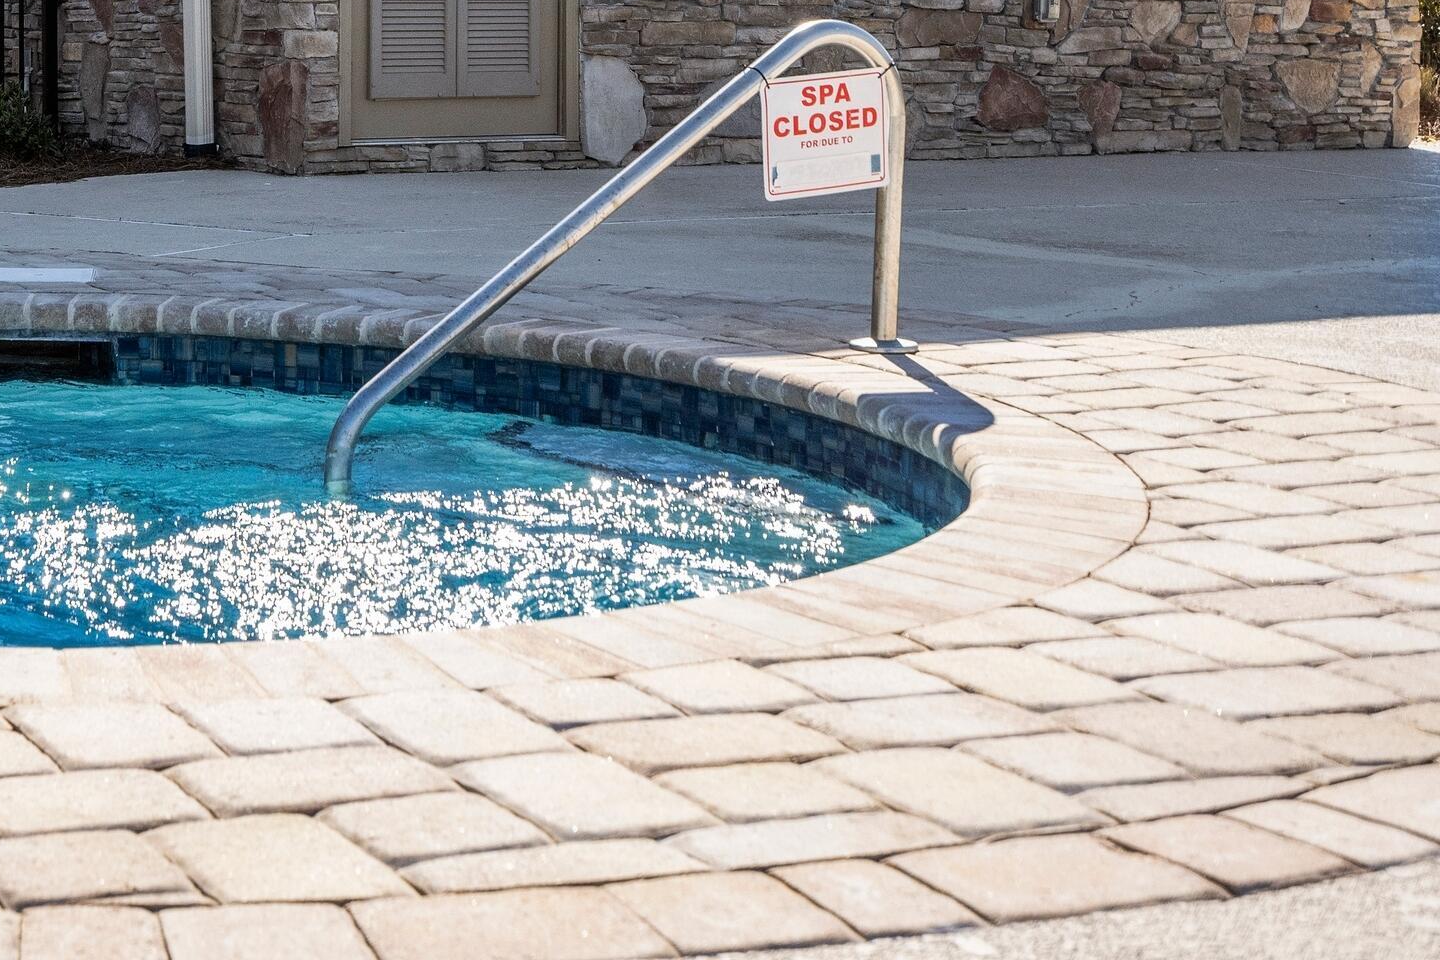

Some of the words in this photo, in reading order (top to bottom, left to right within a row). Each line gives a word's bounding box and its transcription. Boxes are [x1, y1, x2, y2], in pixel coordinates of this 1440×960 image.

[801, 83, 851, 107] SPA
[773, 107, 878, 138] CLOSED
[841, 135, 853, 144] TO
